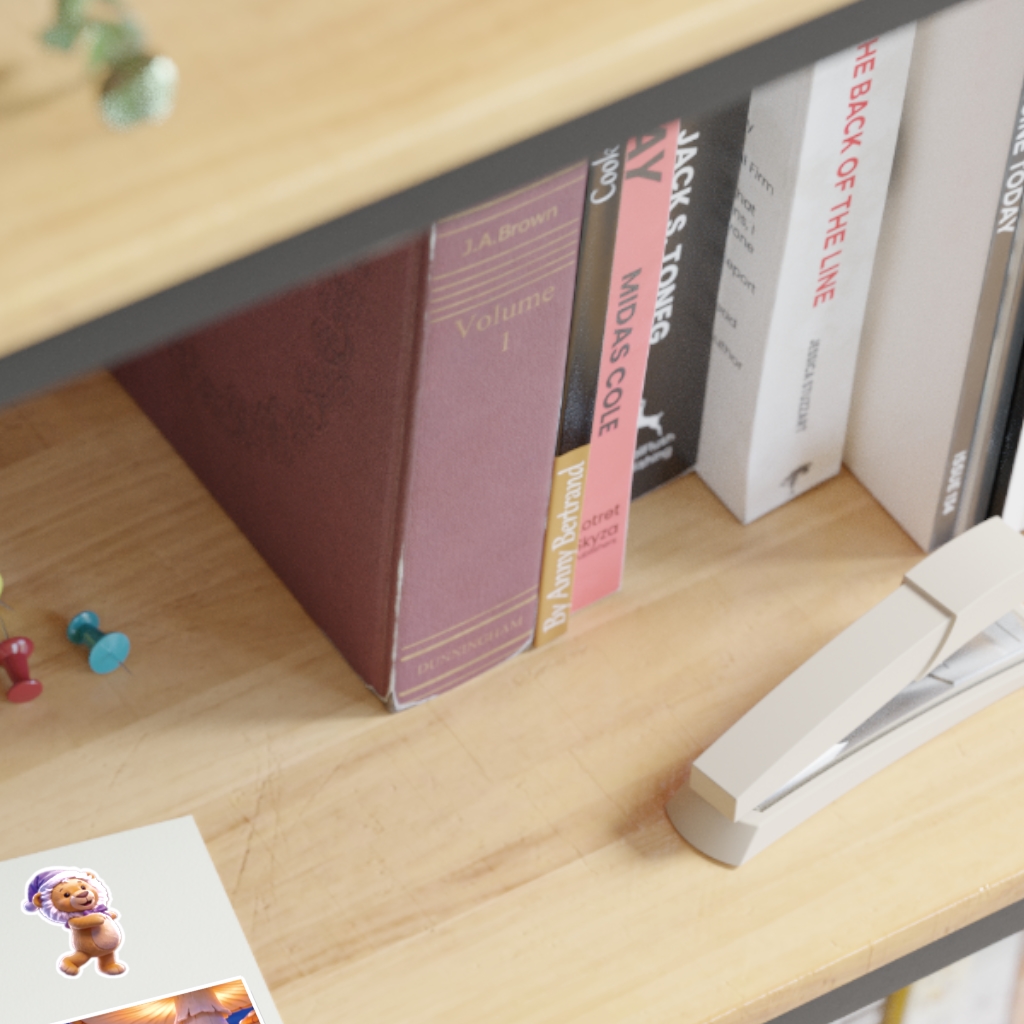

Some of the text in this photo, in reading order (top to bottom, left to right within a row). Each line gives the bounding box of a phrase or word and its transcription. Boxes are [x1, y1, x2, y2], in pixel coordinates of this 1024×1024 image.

[840, 78, 873, 155] BACK
[669, 128, 701, 213] JACK
[834, 156, 859, 192] OF
[823, 194, 853, 250] THE
[454, 284, 556, 339] Volume
[812, 249, 843, 309] LINE
[598, 266, 643, 439] MIDAS COLE
[542, 459, 586, 635] By Anny Bertrand
